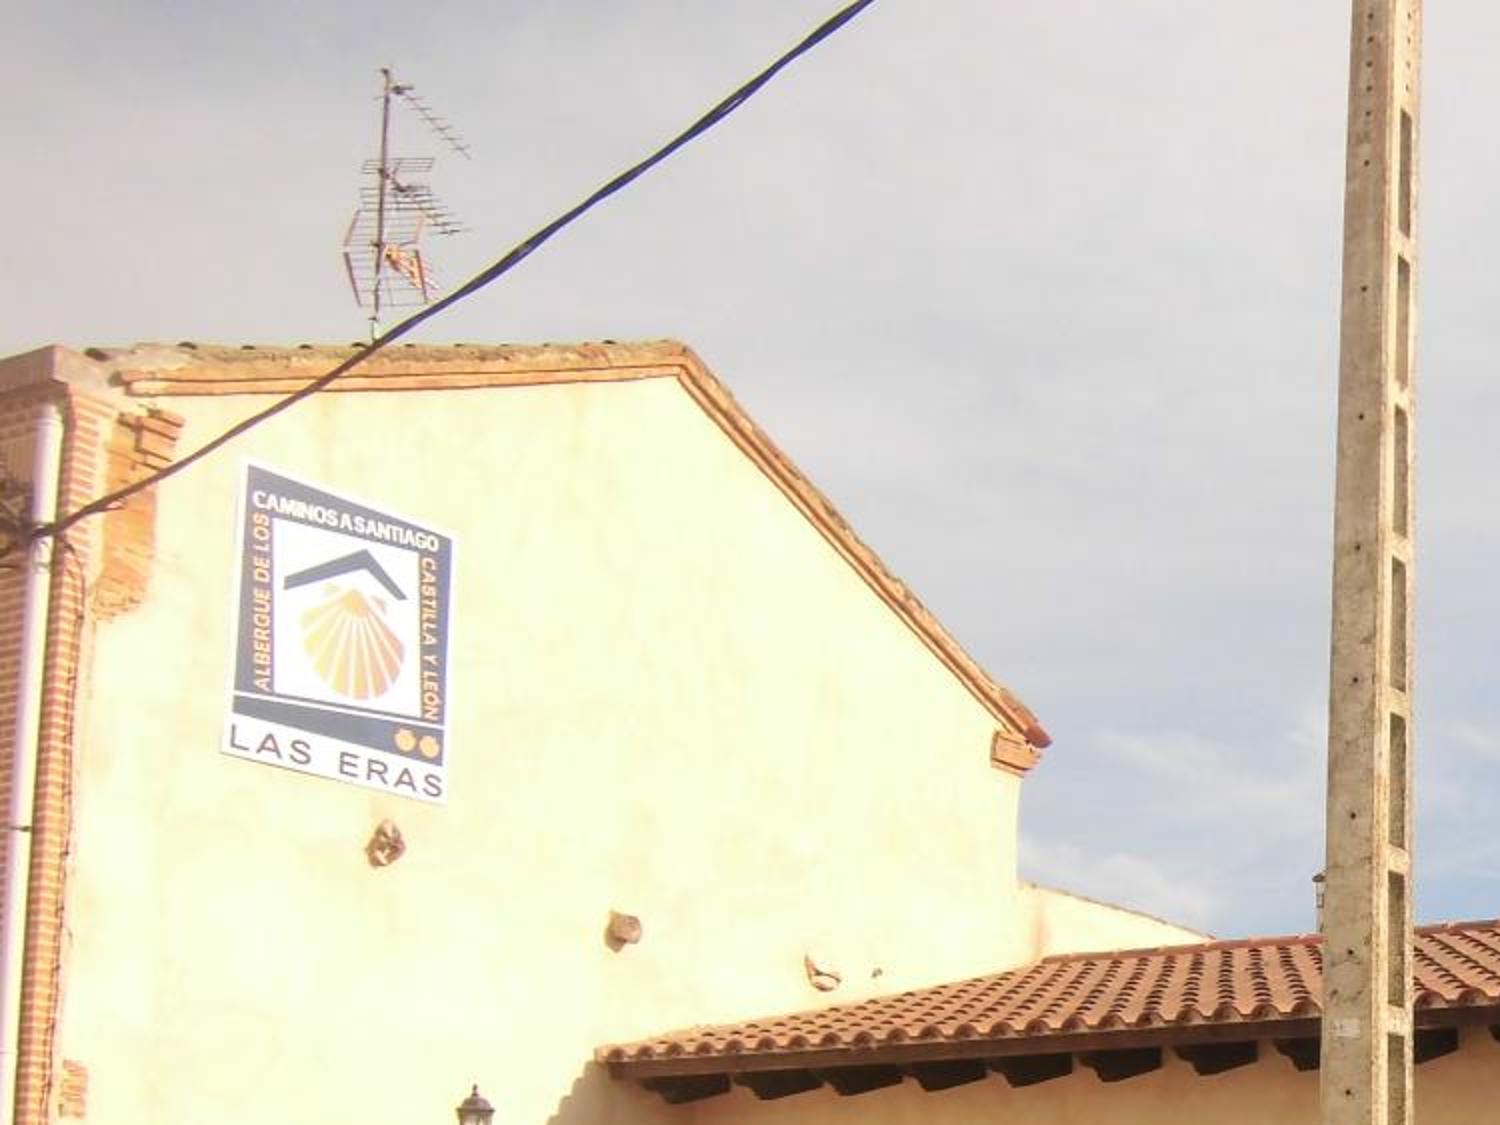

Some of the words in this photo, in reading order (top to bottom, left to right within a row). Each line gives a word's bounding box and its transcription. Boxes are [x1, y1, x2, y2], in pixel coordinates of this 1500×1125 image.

[252, 490, 338, 527] CAMINOS
[340, 513, 353, 531] A
[354, 518, 440, 552] SANTIAGO
[252, 513, 271, 550] LOS
[253, 557, 272, 583] DE
[421, 557, 439, 645] CASTILLA
[253, 588, 273, 692] ALBERGUE
[422, 654, 439, 665] Y
[229, 723, 312, 765] LAS
[339, 752, 443, 798] ERAS
